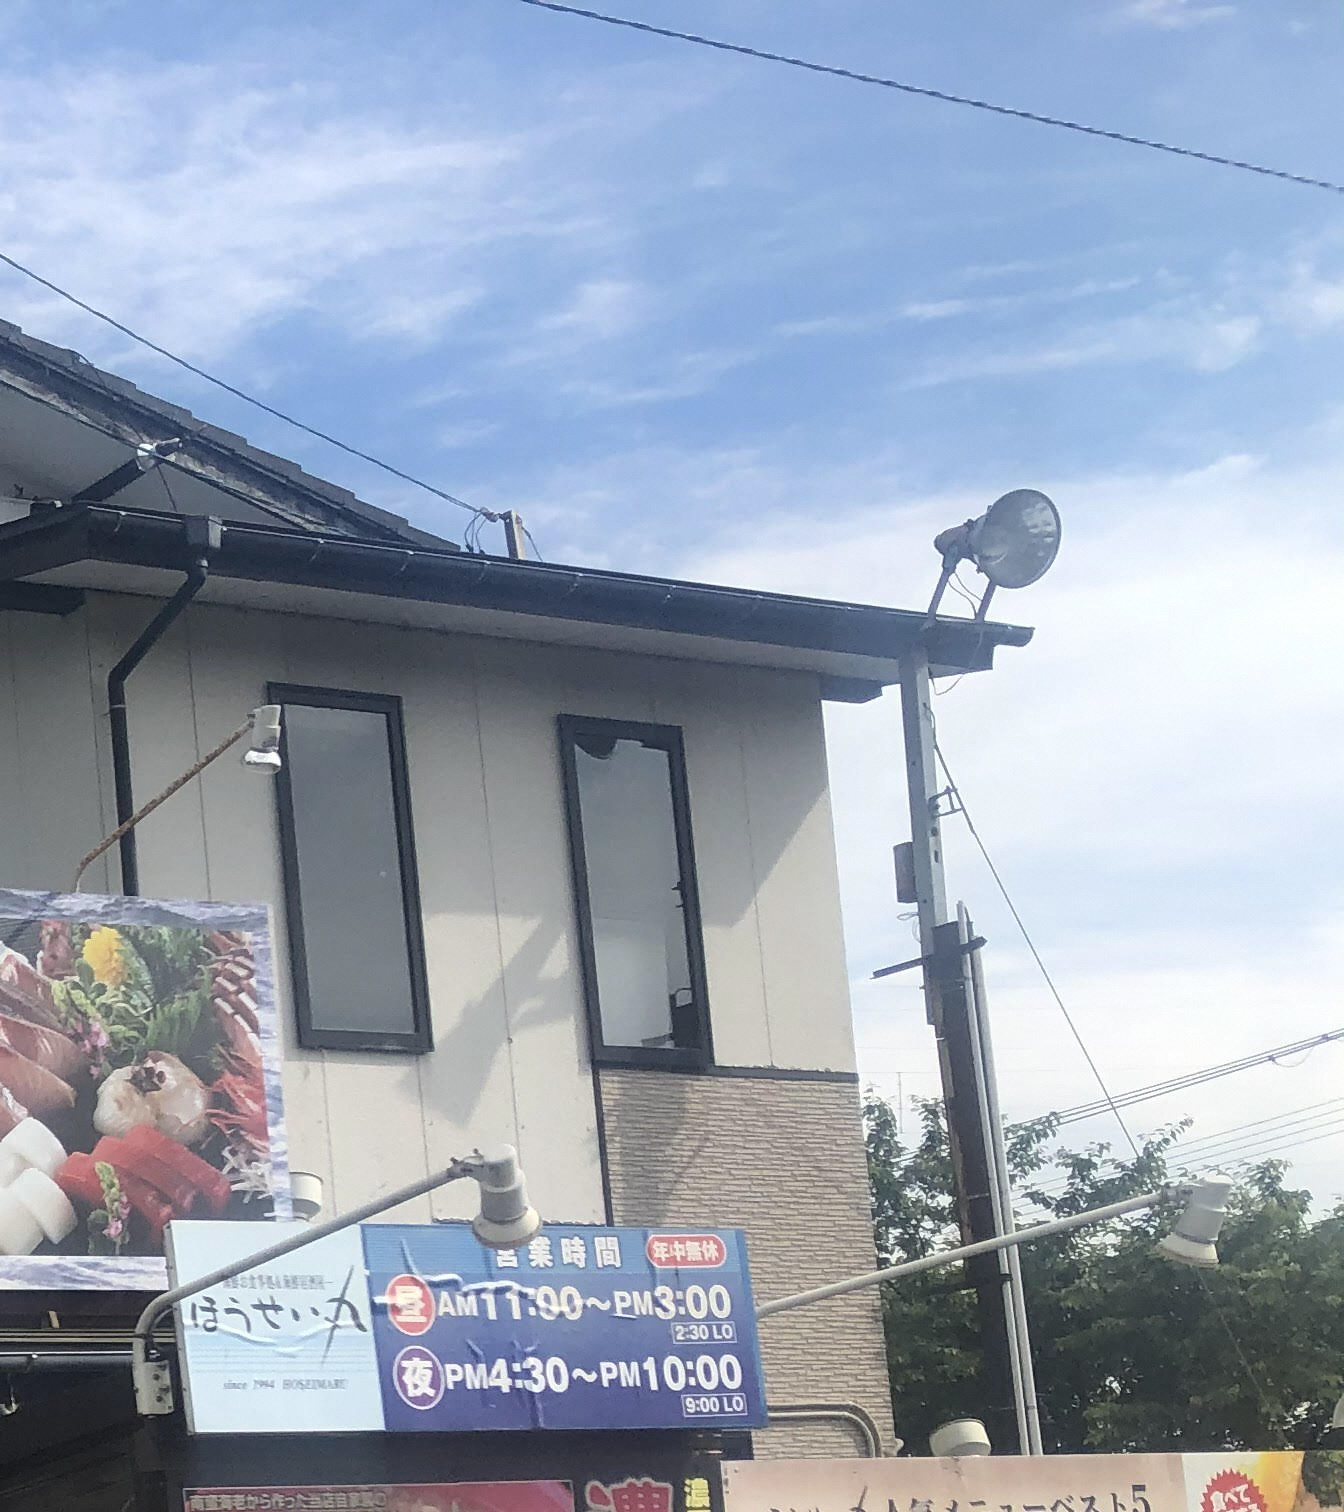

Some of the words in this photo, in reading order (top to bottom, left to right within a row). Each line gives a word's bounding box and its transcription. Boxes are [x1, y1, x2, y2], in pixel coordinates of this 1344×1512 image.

[651, 1238, 722, 1264] 年中無休
[190, 1264, 368, 1367] ほうせい丸
[394, 1284, 428, 1324] 昼
[675, 1324, 709, 1341] 2:30
[712, 1323, 734, 1340] LO
[401, 1357, 437, 1398] 夜
[685, 1397, 720, 1414] 9:00
[722, 1396, 744, 1412] LO
